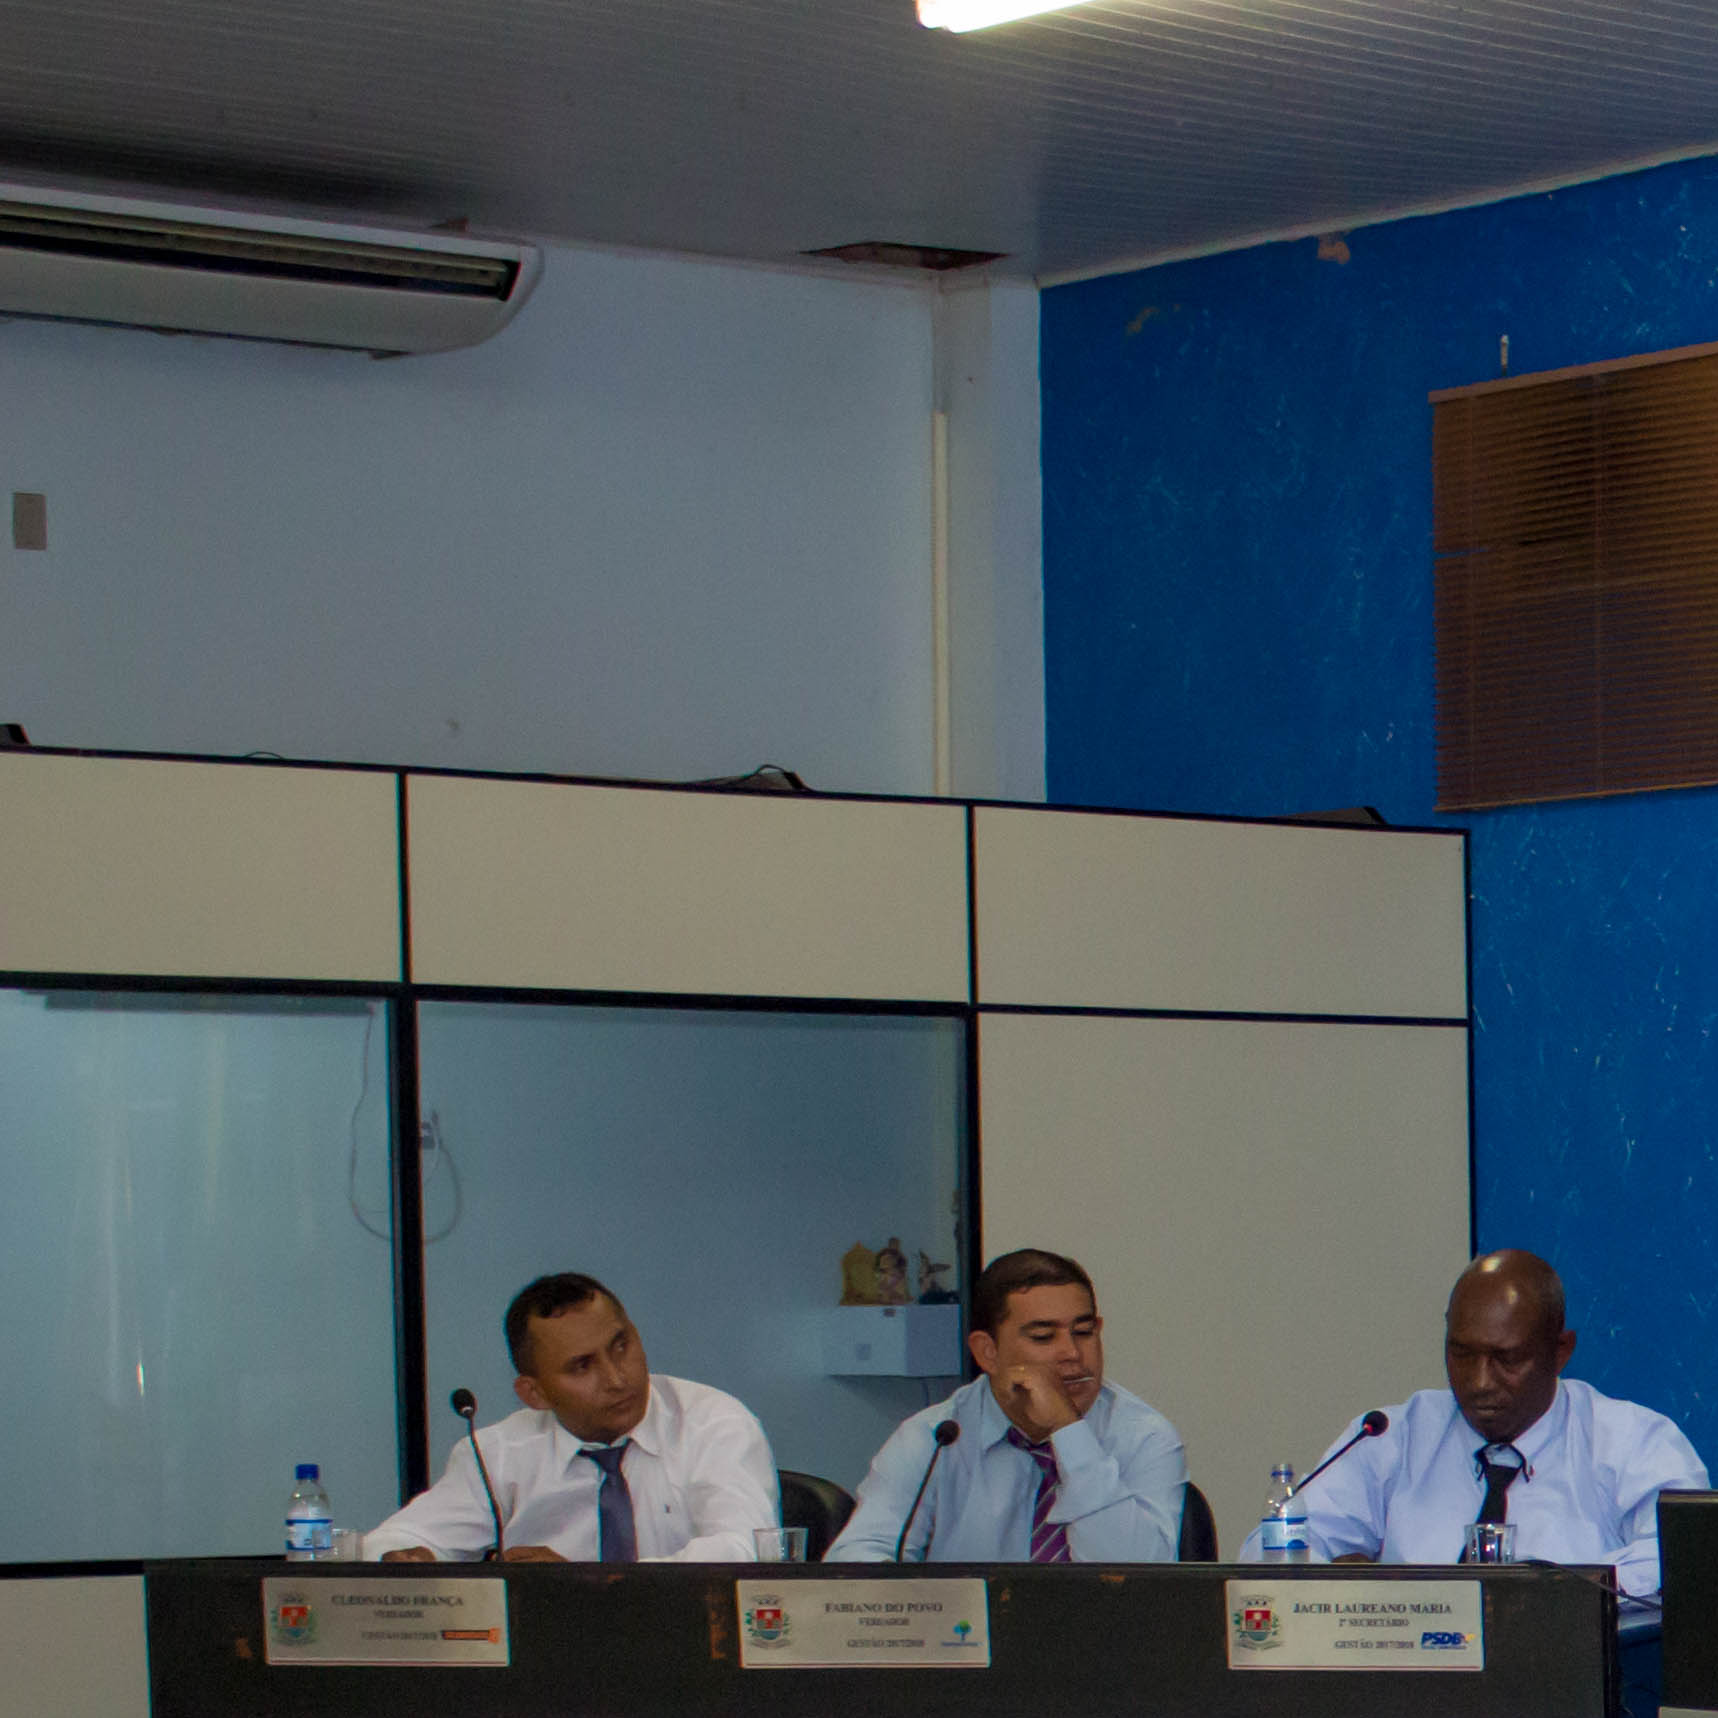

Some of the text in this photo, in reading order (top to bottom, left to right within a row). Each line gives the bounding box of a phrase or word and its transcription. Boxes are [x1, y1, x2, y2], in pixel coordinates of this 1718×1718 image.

[824, 1603, 943, 1613] FABIANO DO POVO
[1293, 1603, 1452, 1614] JACIR LAUREANO MARIA
[1421, 1631, 1464, 1645] PSDB
